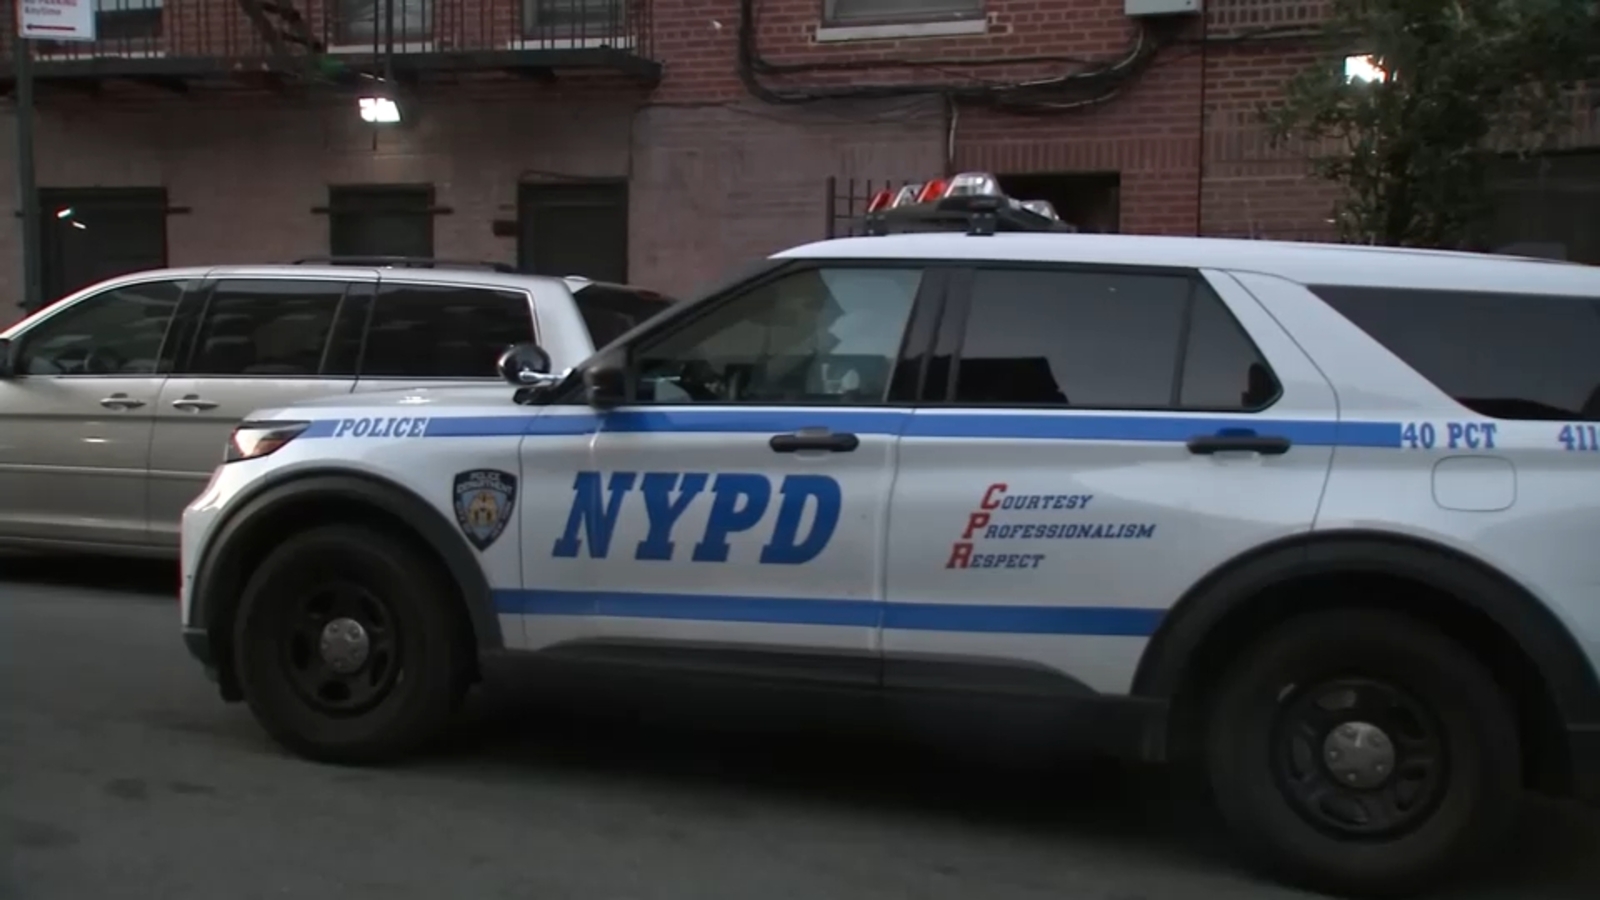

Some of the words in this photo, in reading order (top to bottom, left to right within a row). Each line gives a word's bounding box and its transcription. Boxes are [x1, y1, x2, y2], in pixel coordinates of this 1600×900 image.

[335, 417, 428, 437] POLICE
[1401, 422, 1436, 449] 40
[1447, 422, 1498, 449] PCT
[1558, 424, 1599, 451] 411
[980, 483, 1093, 511] COURTESY
[552, 471, 842, 565] NYPD
[961, 512, 1156, 539] PROFESSIONALISM
[945, 543, 1045, 570] RESPECT
